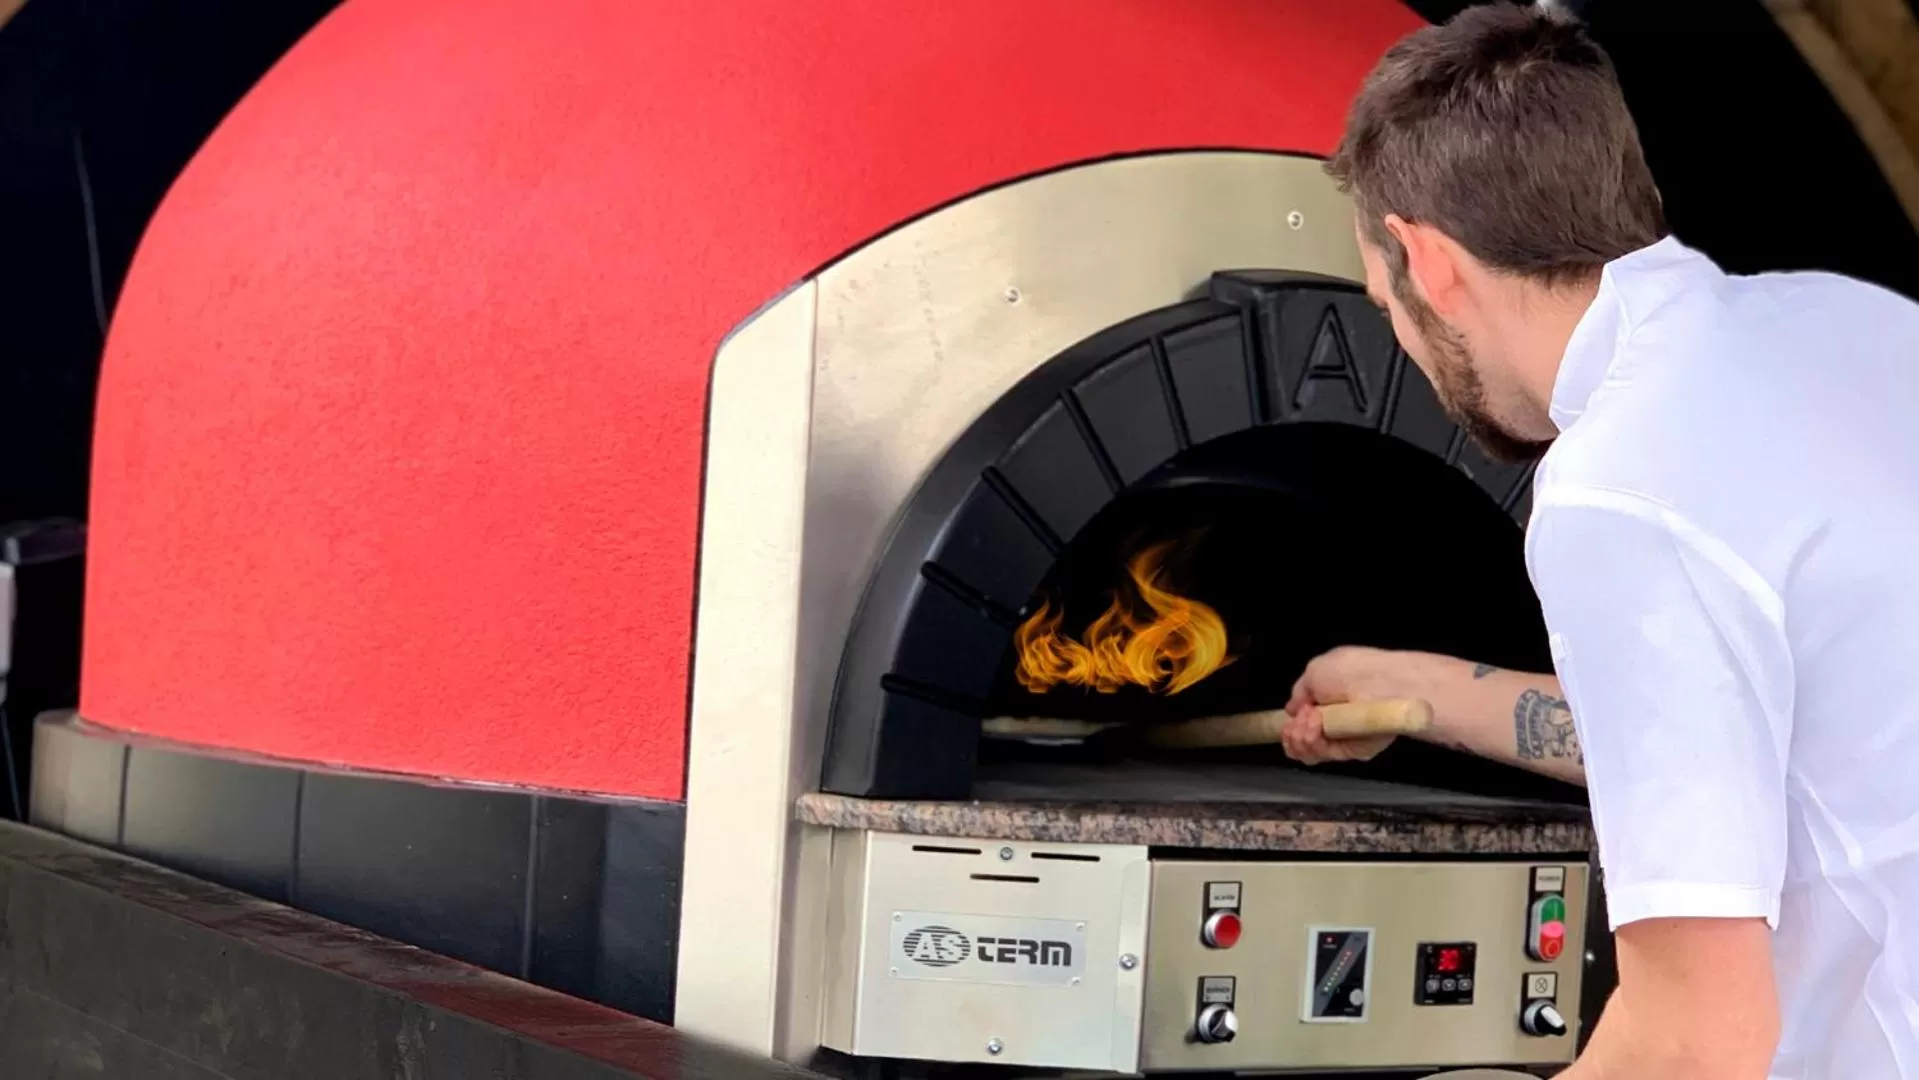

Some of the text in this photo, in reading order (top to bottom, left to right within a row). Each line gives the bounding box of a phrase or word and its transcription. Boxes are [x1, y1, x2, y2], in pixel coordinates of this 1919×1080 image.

[1293, 302, 1369, 412] A
[910, 930, 1072, 967] AS TERM
